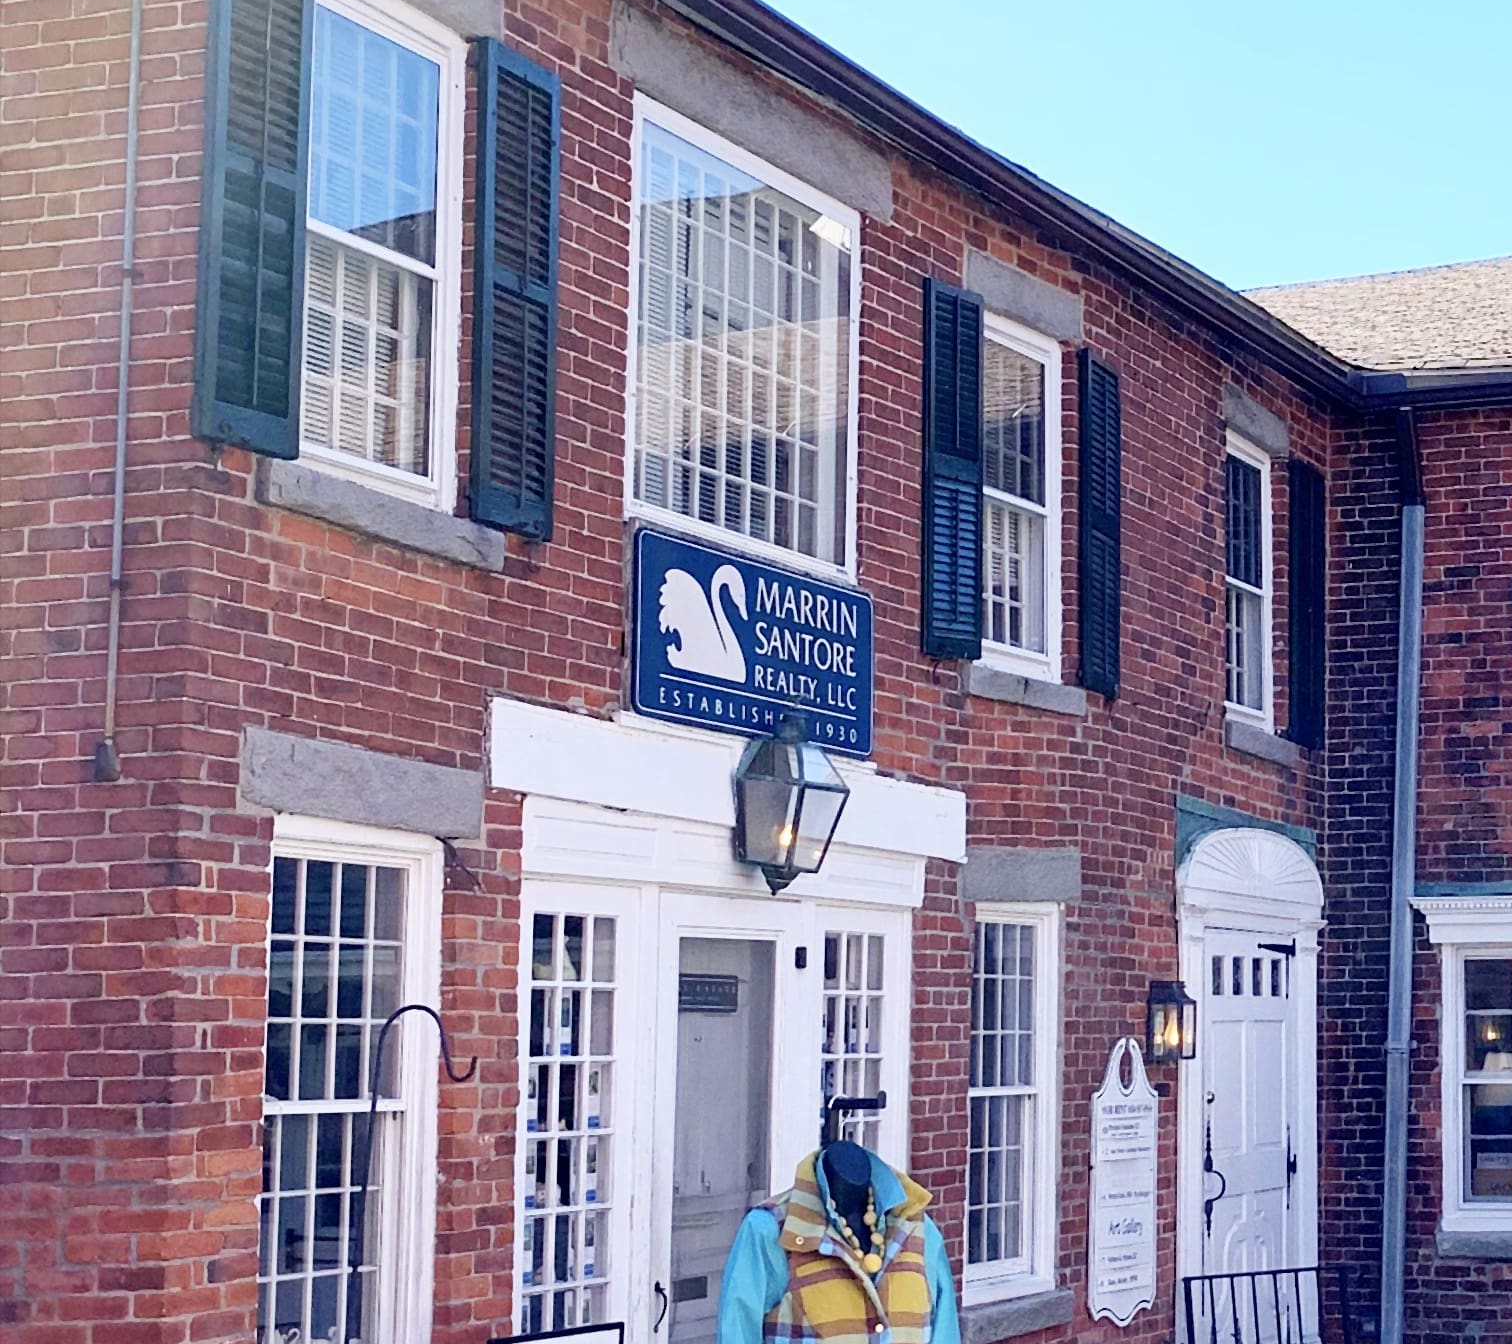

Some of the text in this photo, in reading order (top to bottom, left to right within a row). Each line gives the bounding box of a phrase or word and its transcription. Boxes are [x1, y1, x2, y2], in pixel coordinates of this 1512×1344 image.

[755, 576, 858, 639] MARRIN
[754, 622, 857, 678] SANTORE
[754, 664, 857, 710] REALTY, LLC
[659, 687, 858, 744] ESTABLISH 1930
